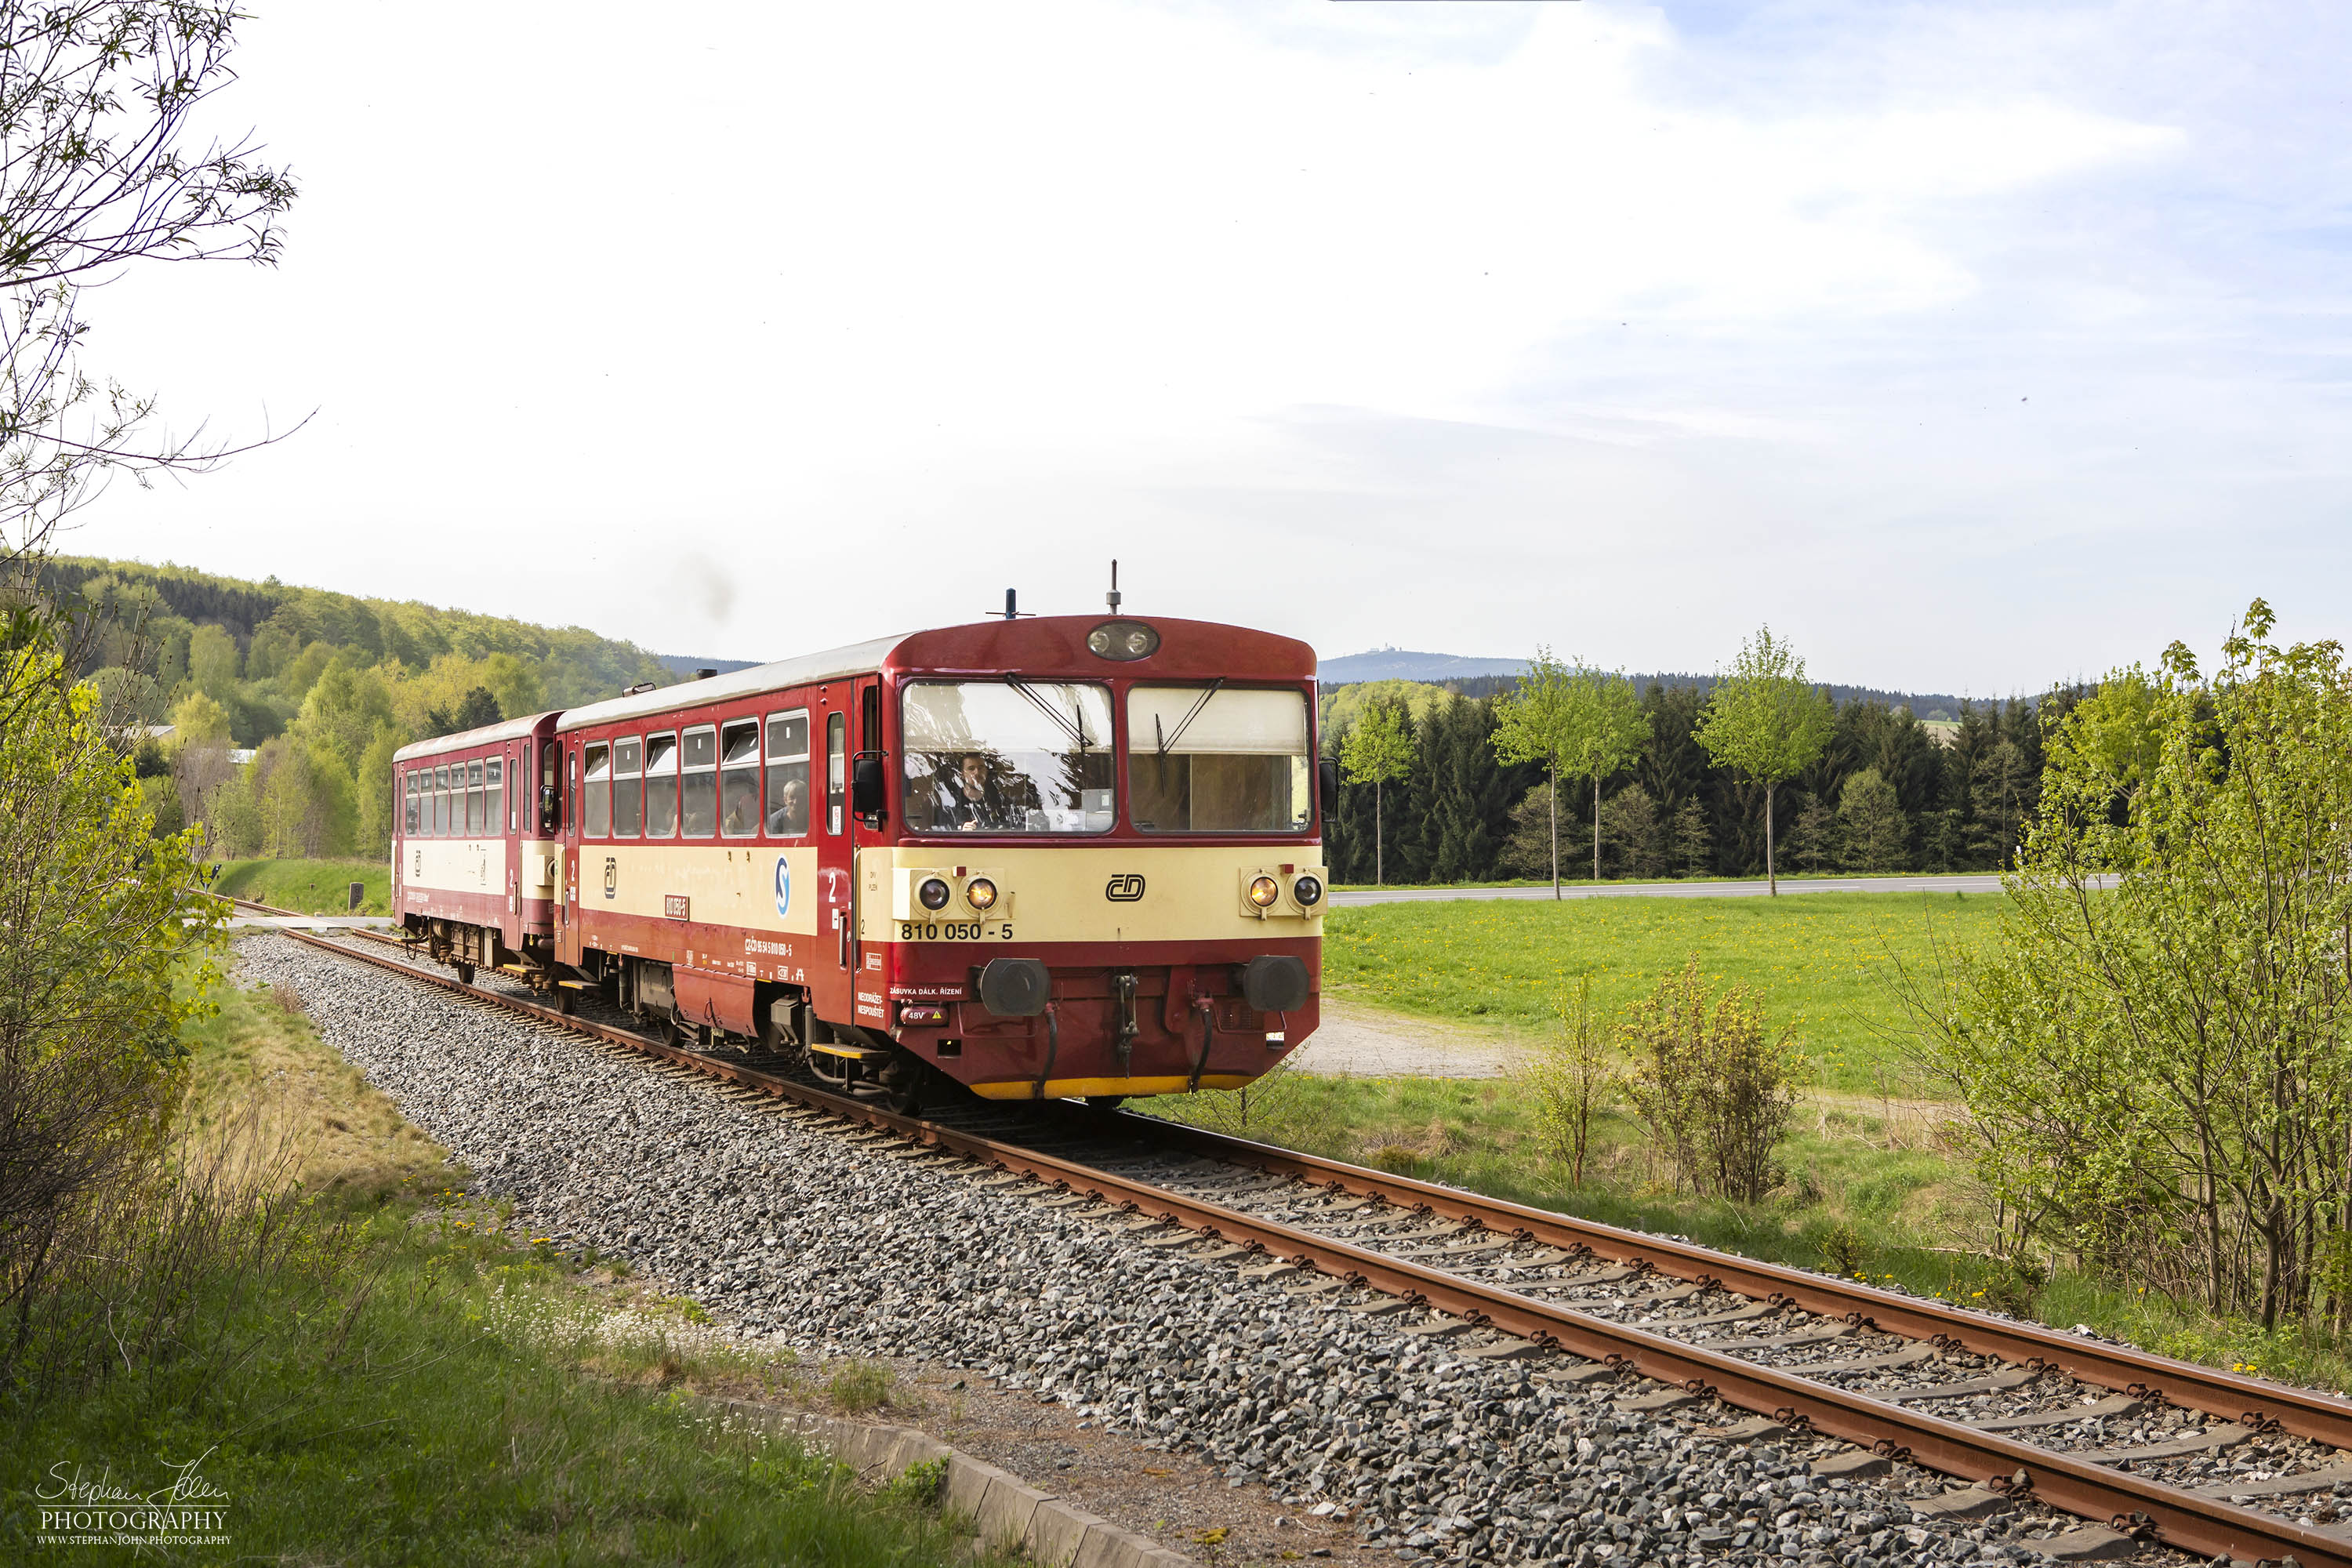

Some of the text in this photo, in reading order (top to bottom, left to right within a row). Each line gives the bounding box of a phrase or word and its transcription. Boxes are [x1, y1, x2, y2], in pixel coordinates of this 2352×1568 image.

[509, 868, 514, 888] 2
[571, 859, 575, 882] 2
[829, 872, 837, 903] 2
[861, 919, 866, 935] 2
[902, 923, 938, 940] 810
[944, 923, 981, 940] 050
[1001, 923, 1013, 940] 5
[890, 986, 917, 995] ZÁSUVKA
[919, 986, 938, 995] DÁLK.
